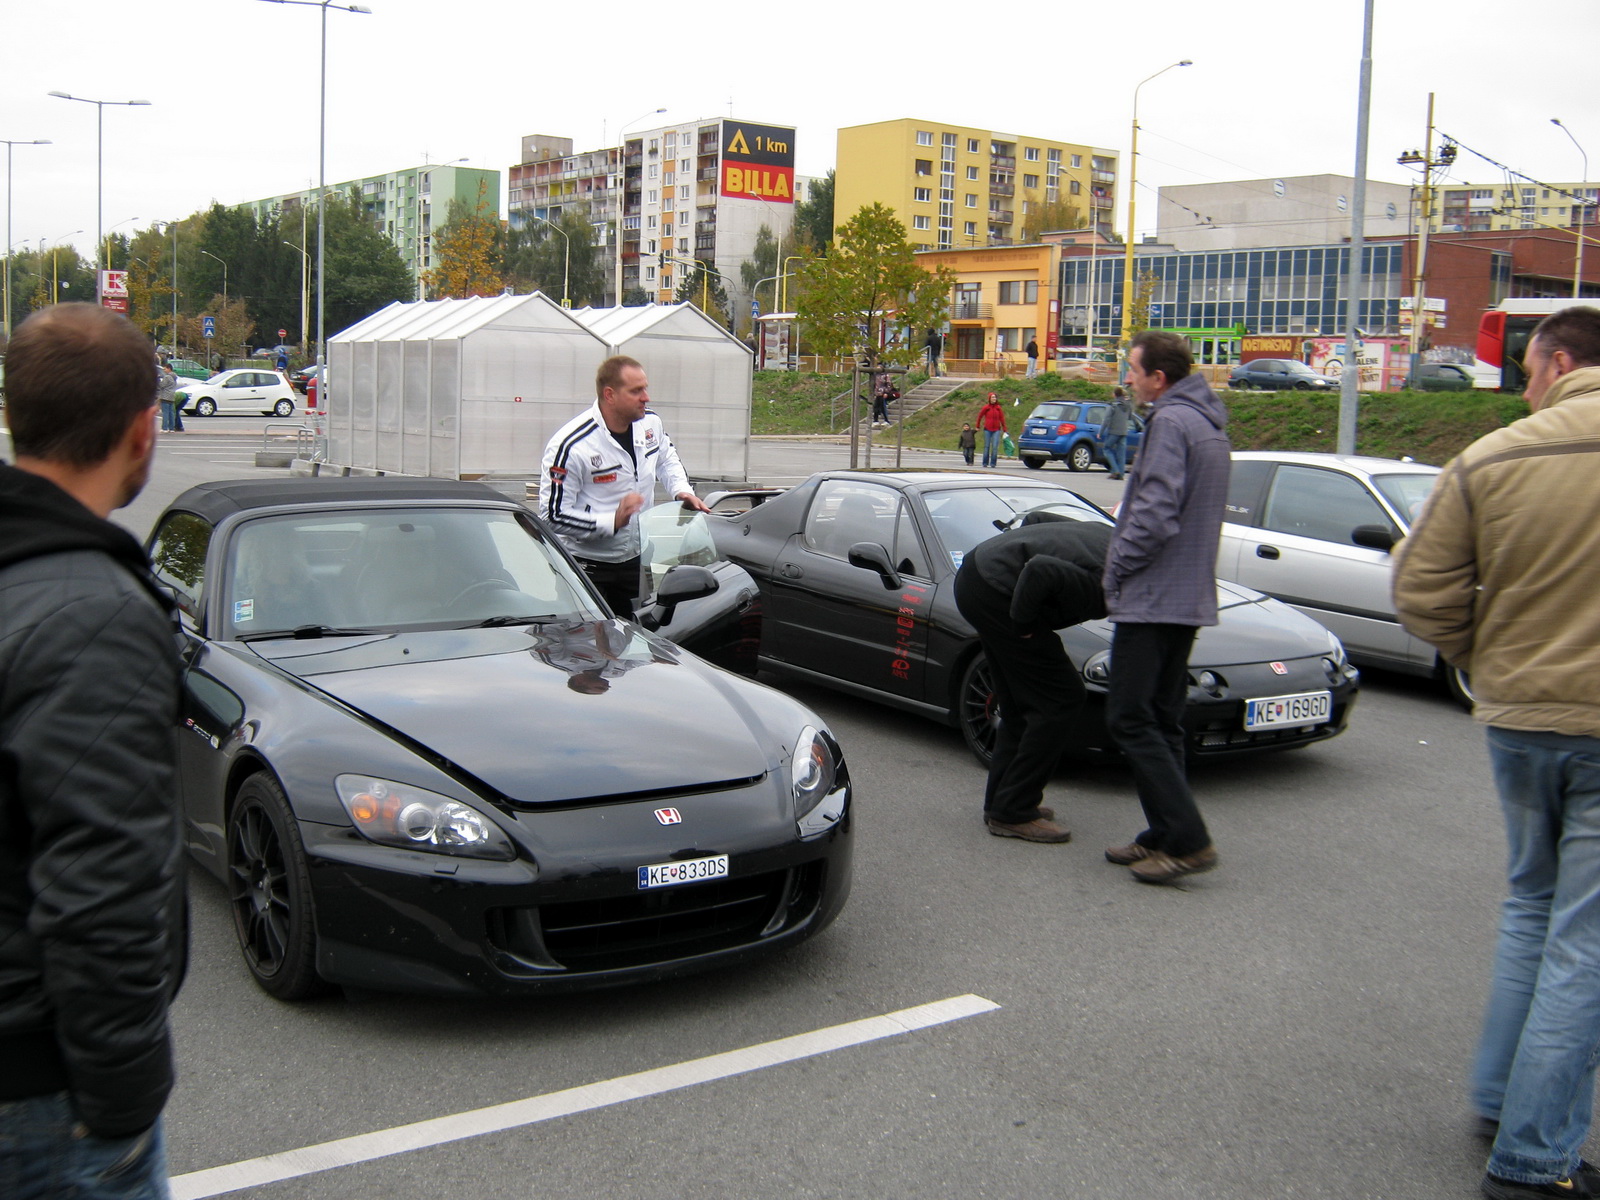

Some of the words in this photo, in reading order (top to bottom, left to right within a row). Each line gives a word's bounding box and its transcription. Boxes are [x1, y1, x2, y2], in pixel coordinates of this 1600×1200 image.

[755, 136, 762, 151] 1
[767, 137, 787, 153] km
[726, 167, 790, 197] BILLA
[1256, 702, 1275, 723] KE
[1285, 696, 1328, 720] 169GD
[650, 866, 670, 886] KE
[678, 858, 726, 881] 833DS
